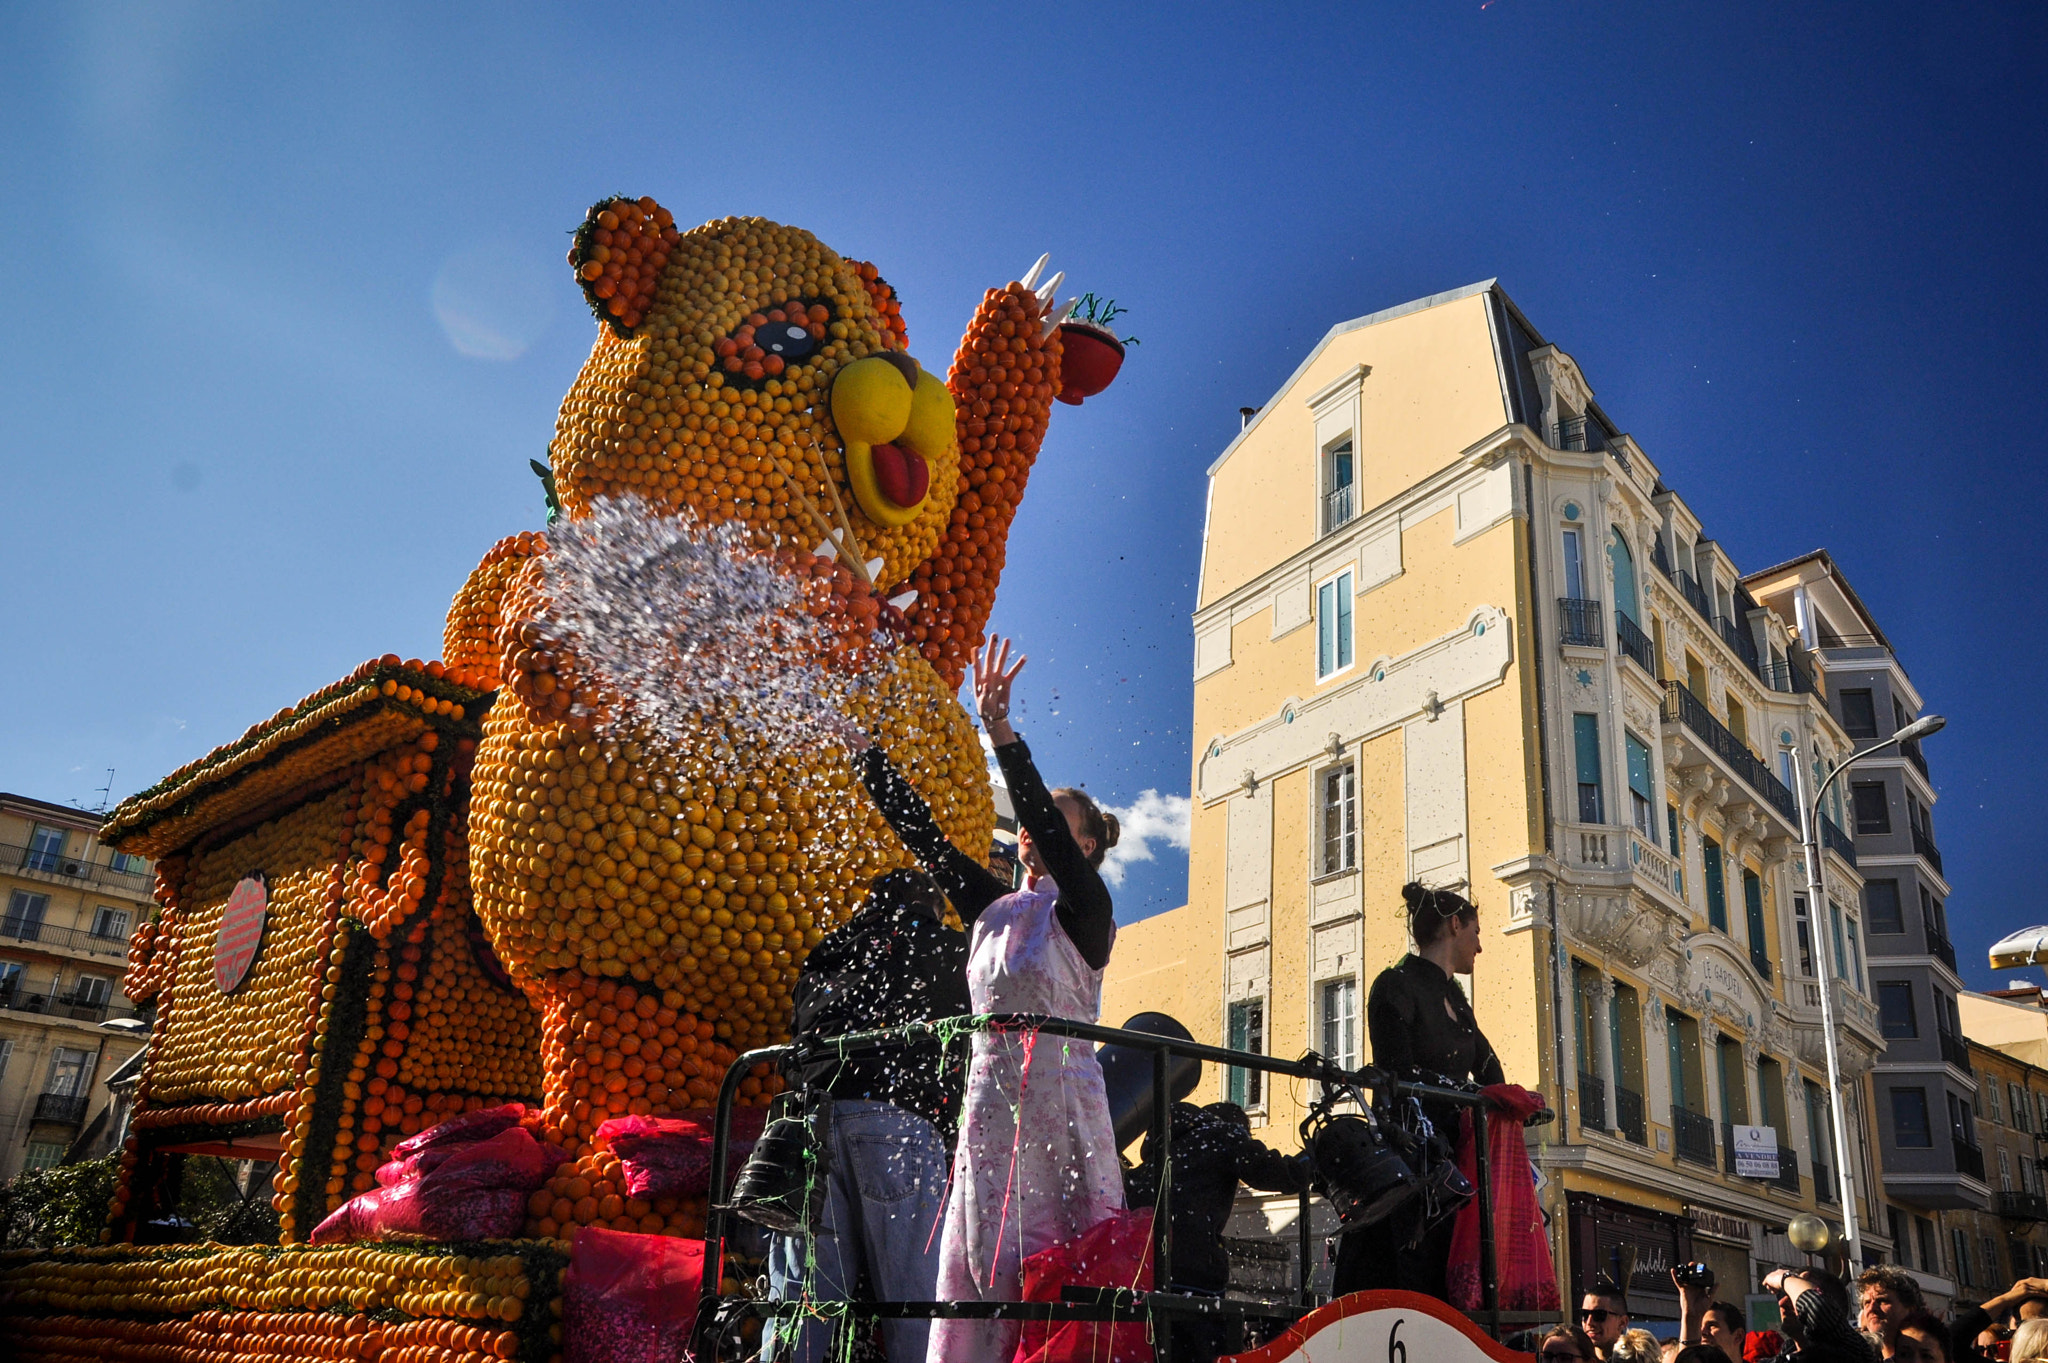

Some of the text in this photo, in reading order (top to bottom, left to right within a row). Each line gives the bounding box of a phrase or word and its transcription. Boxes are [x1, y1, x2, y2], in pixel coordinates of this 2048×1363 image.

[1703, 960, 1743, 1000] LE GARDEN
[1744, 1152, 1778, 1160] VENDRE
[1388, 1318, 1407, 1363] 6
